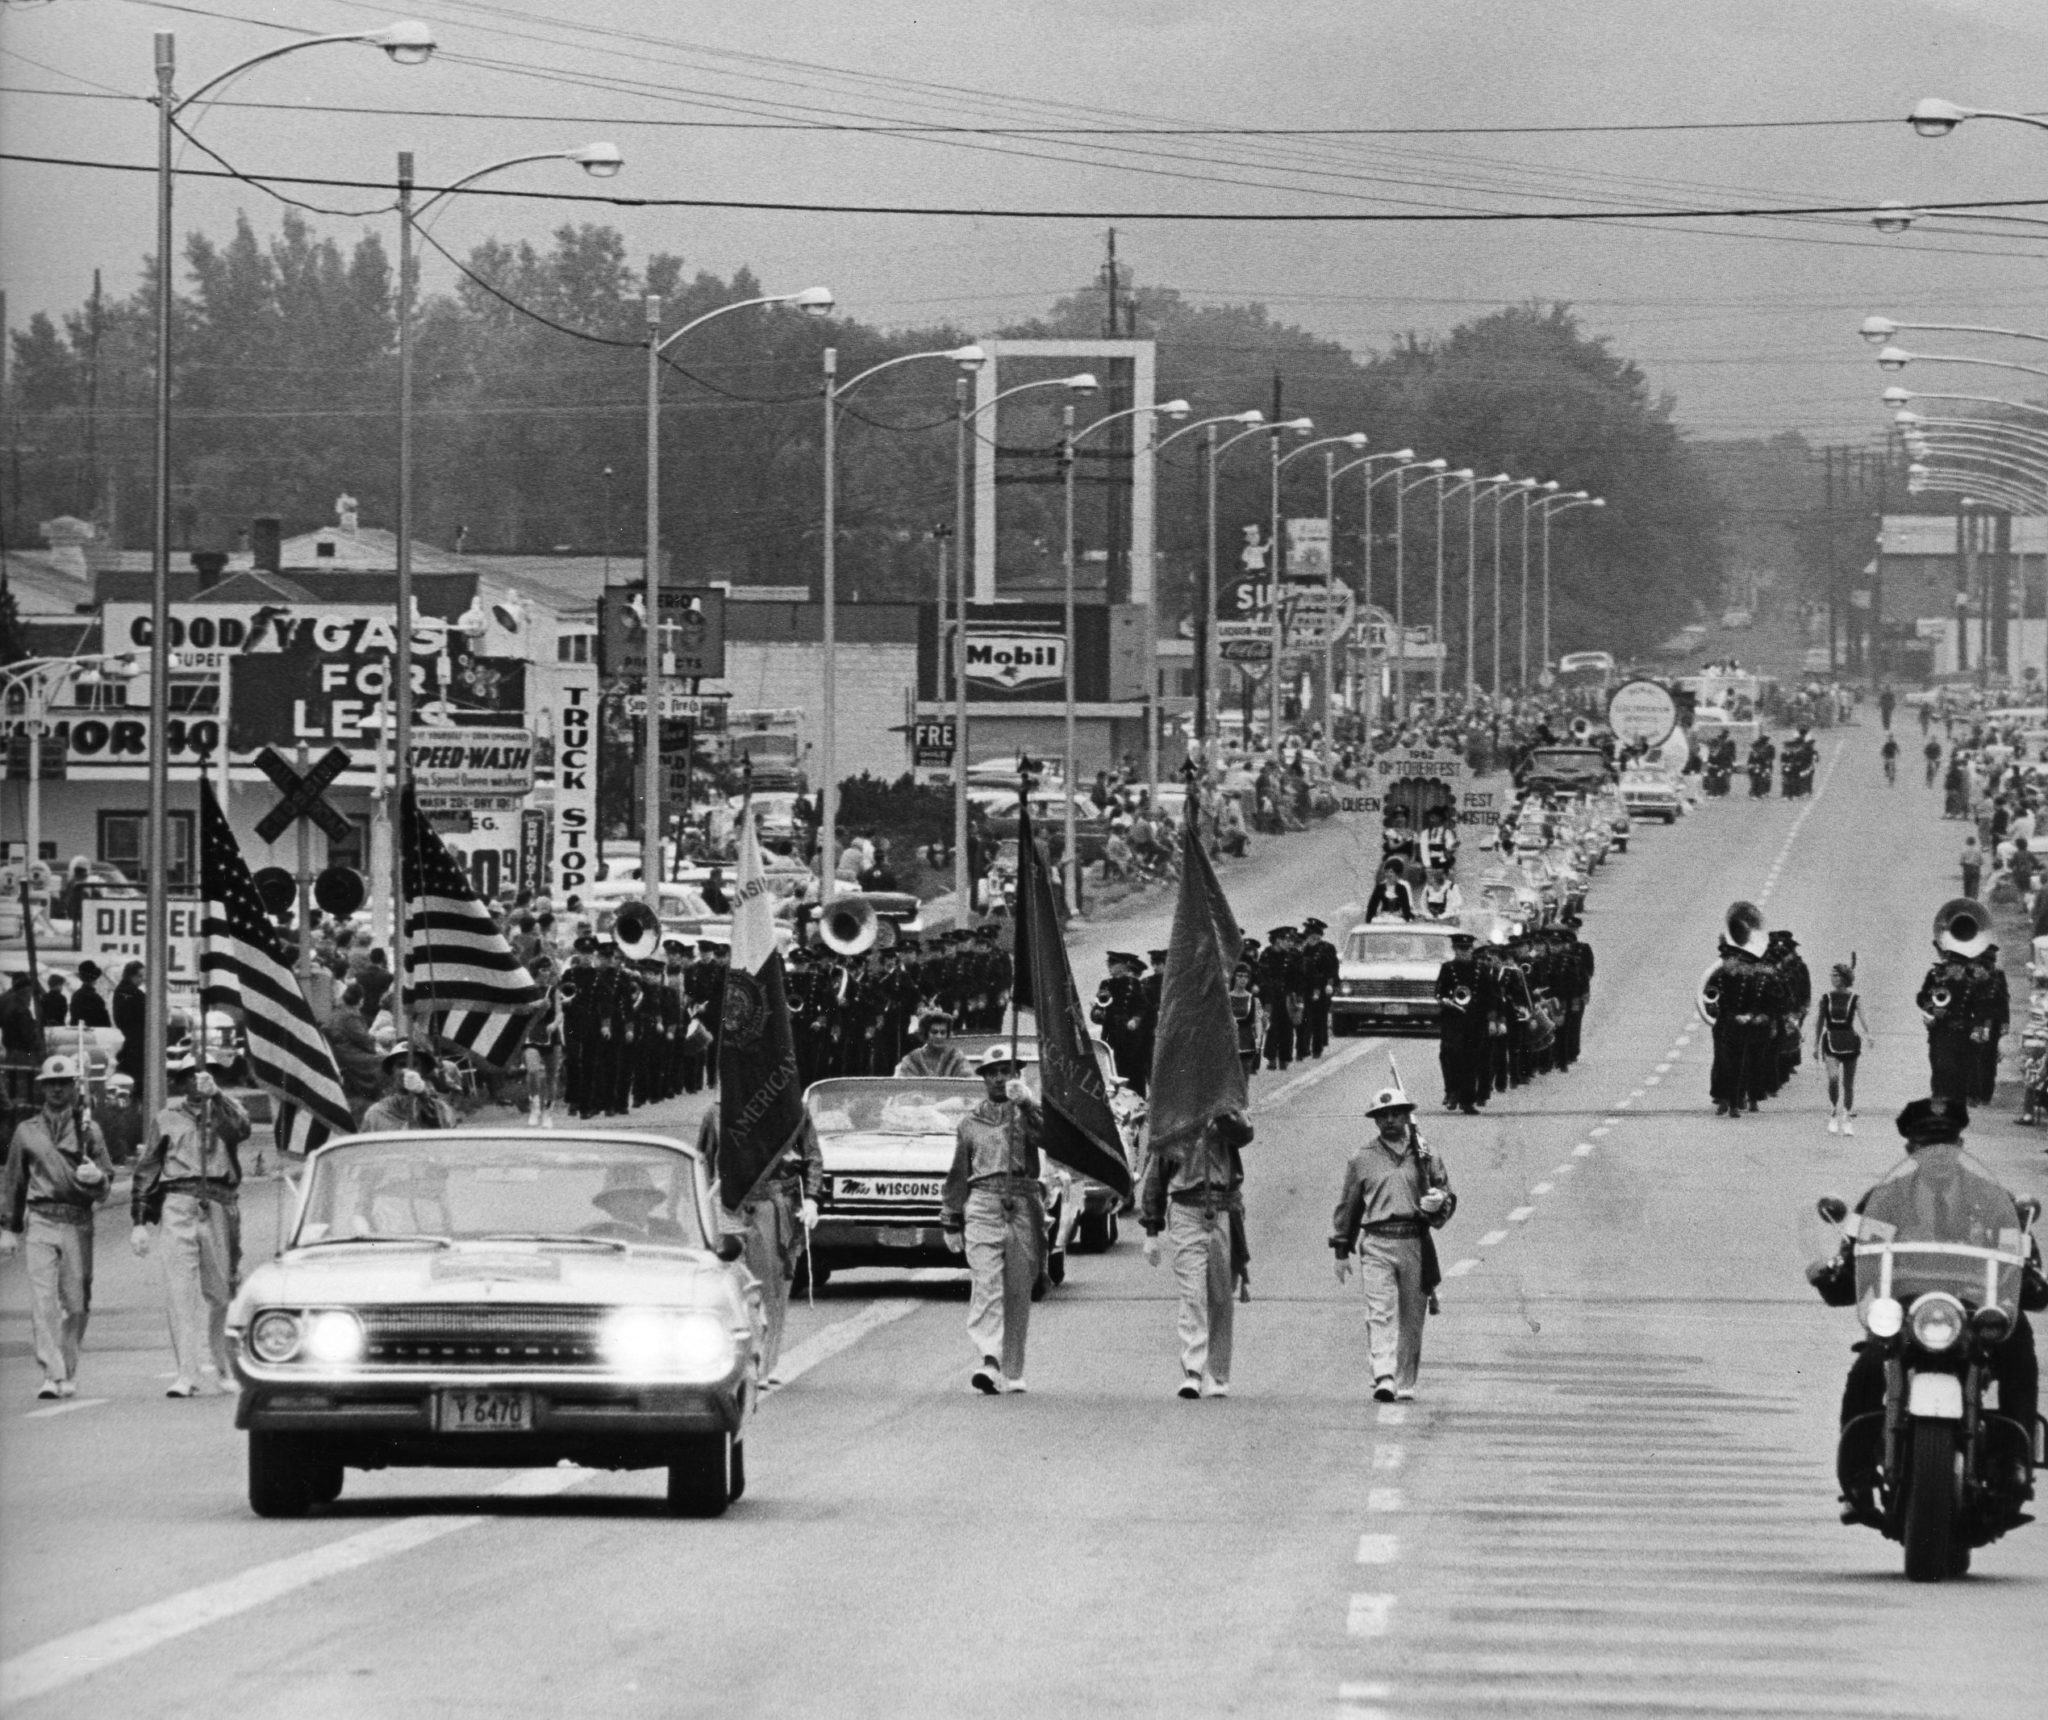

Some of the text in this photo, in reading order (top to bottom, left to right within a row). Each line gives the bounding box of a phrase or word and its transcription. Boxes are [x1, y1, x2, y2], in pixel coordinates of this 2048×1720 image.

[313, 614, 448, 655] GAS
[967, 646, 1056, 666] Mobil
[322, 664, 427, 695] FOR
[916, 725, 953, 746] FRE
[561, 687, 589, 891] TRUCK STOP
[1464, 792, 1493, 808] FEST
[1341, 797, 1380, 812] QUEEN
[471, 817, 499, 831] EG.
[525, 821, 538, 895] REMINGTO
[97, 908, 201, 938] DIEEL
